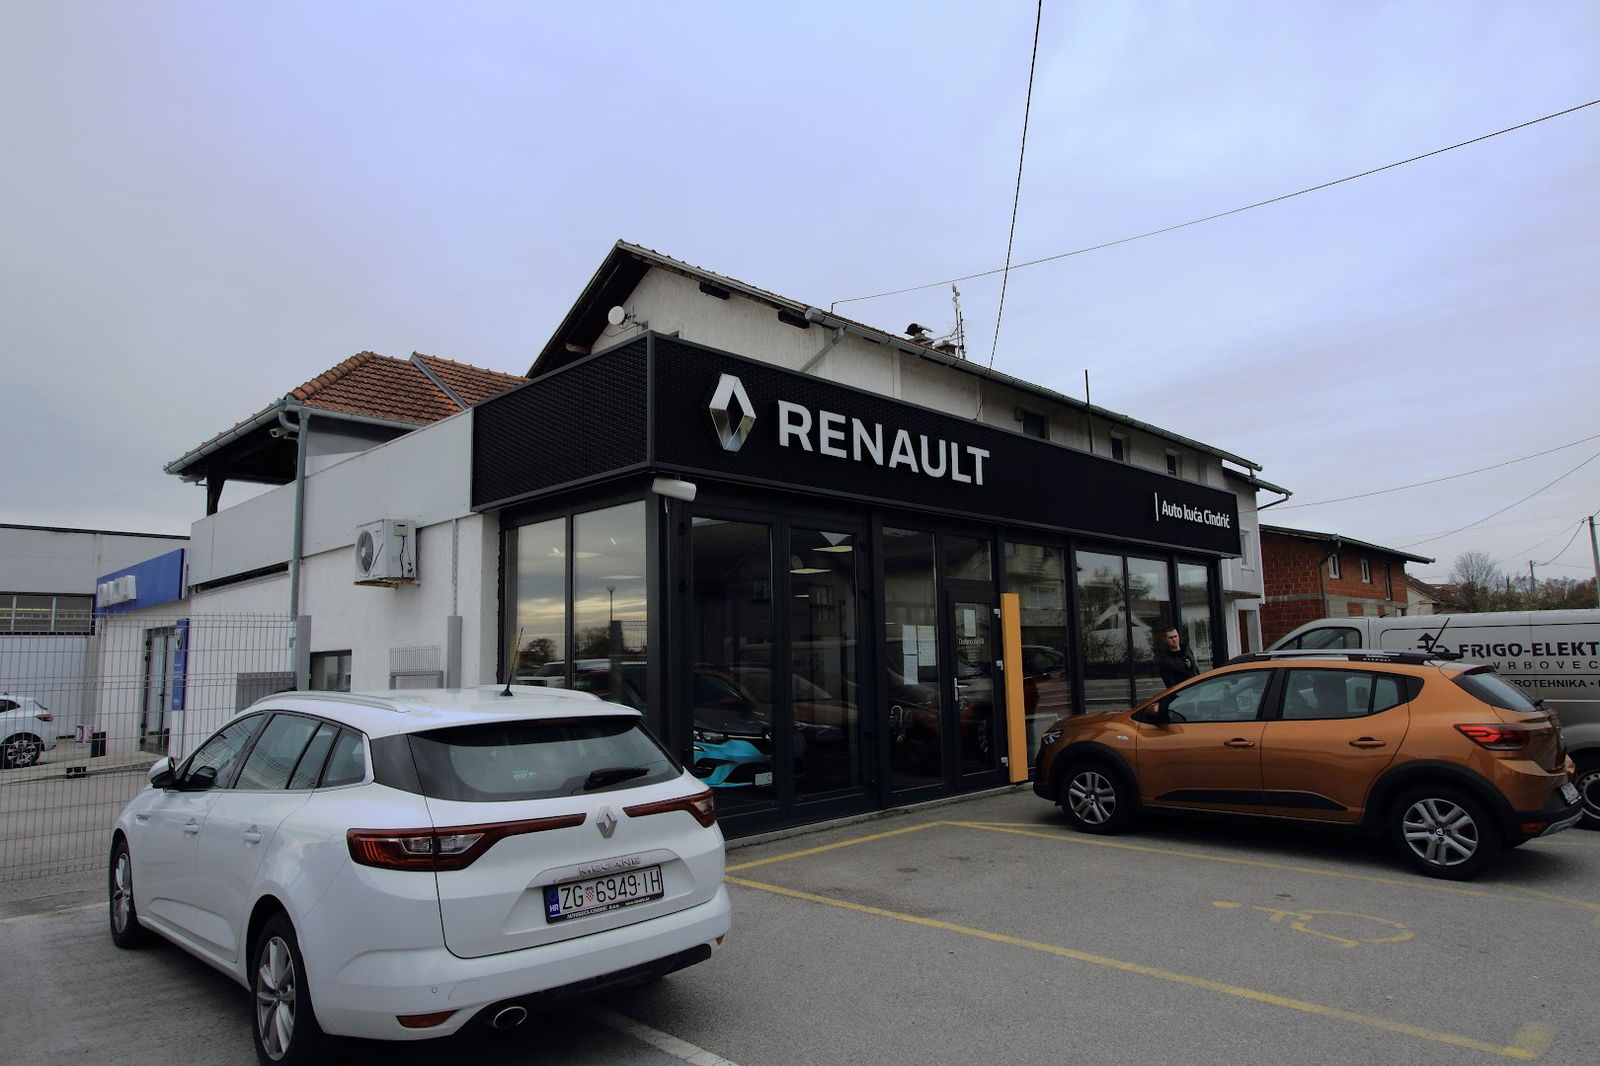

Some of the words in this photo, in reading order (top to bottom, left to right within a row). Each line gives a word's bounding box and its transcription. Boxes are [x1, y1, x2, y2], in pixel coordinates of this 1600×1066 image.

[778, 400, 990, 485] RENAULT
[1162, 500, 1182, 519] Auto
[1183, 504, 1203, 523] kuća
[1204, 509, 1230, 528] Cindrić
[1493, 660, 1598, 670] VRBOVEC
[550, 903, 560, 912] HR
[560, 885, 584, 910] ZG
